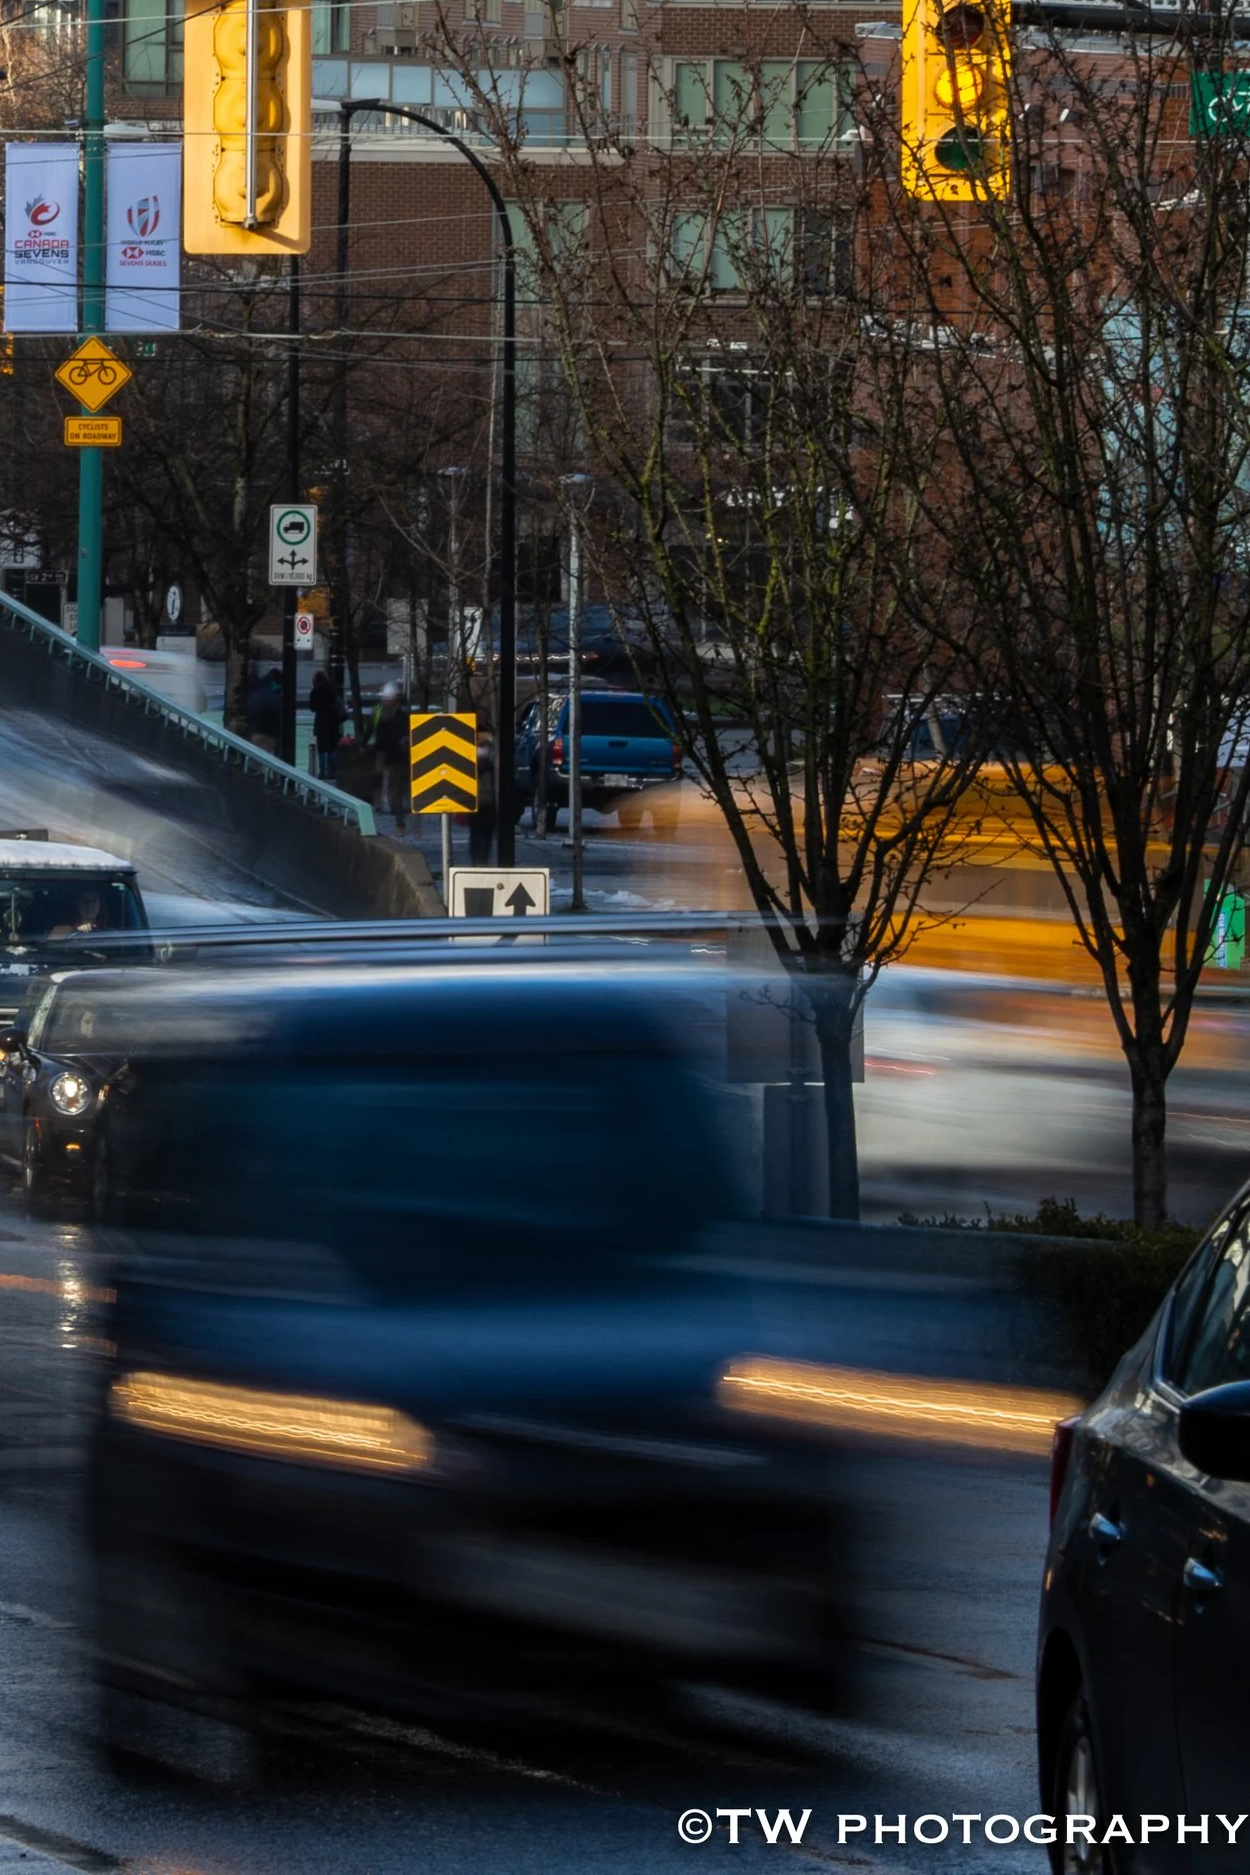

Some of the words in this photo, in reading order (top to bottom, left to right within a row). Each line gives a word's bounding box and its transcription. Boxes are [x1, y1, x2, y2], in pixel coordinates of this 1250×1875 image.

[14, 239, 70, 249] CANADA
[14, 249, 70, 259] SEVENS
[82, 432, 117, 440] ROADWAY
